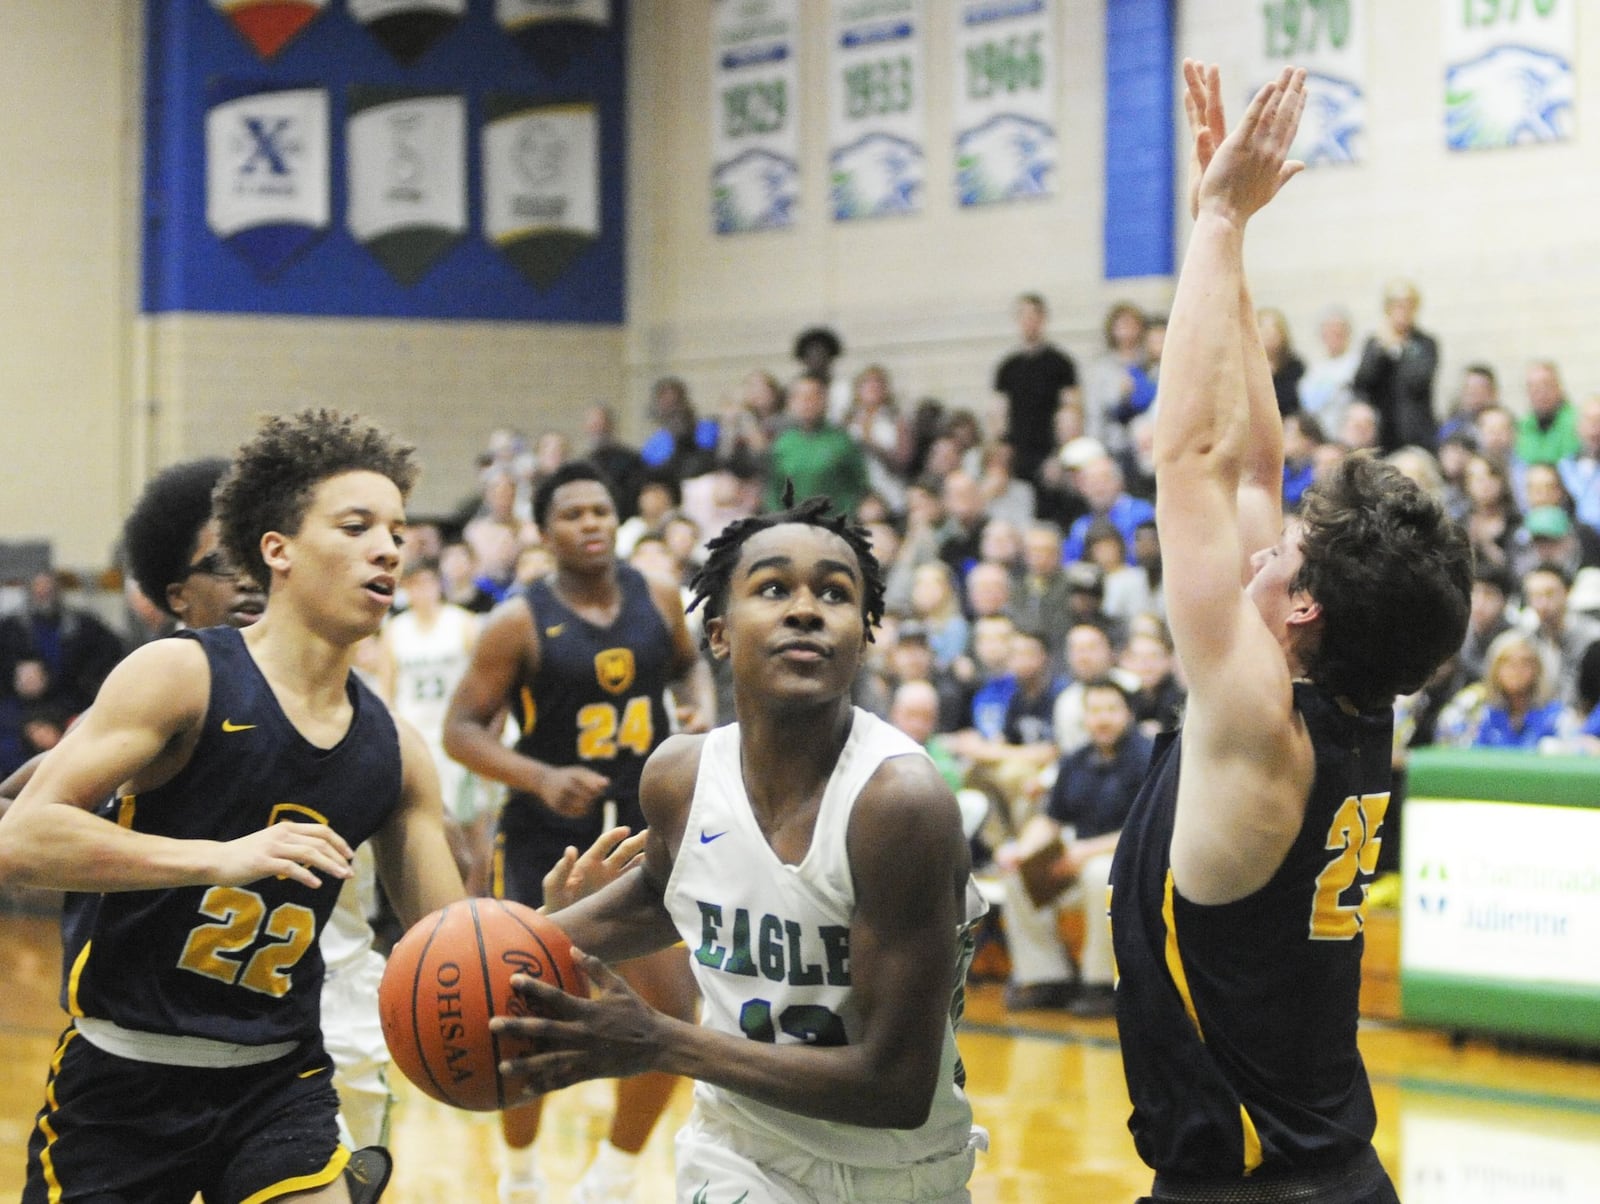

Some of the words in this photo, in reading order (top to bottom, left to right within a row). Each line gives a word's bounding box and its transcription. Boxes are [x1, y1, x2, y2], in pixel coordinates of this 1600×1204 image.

[237, 114, 291, 176] X
[576, 696, 654, 761] 24
[176, 885, 316, 998] 22
[436, 962, 474, 1085] OHSAA
